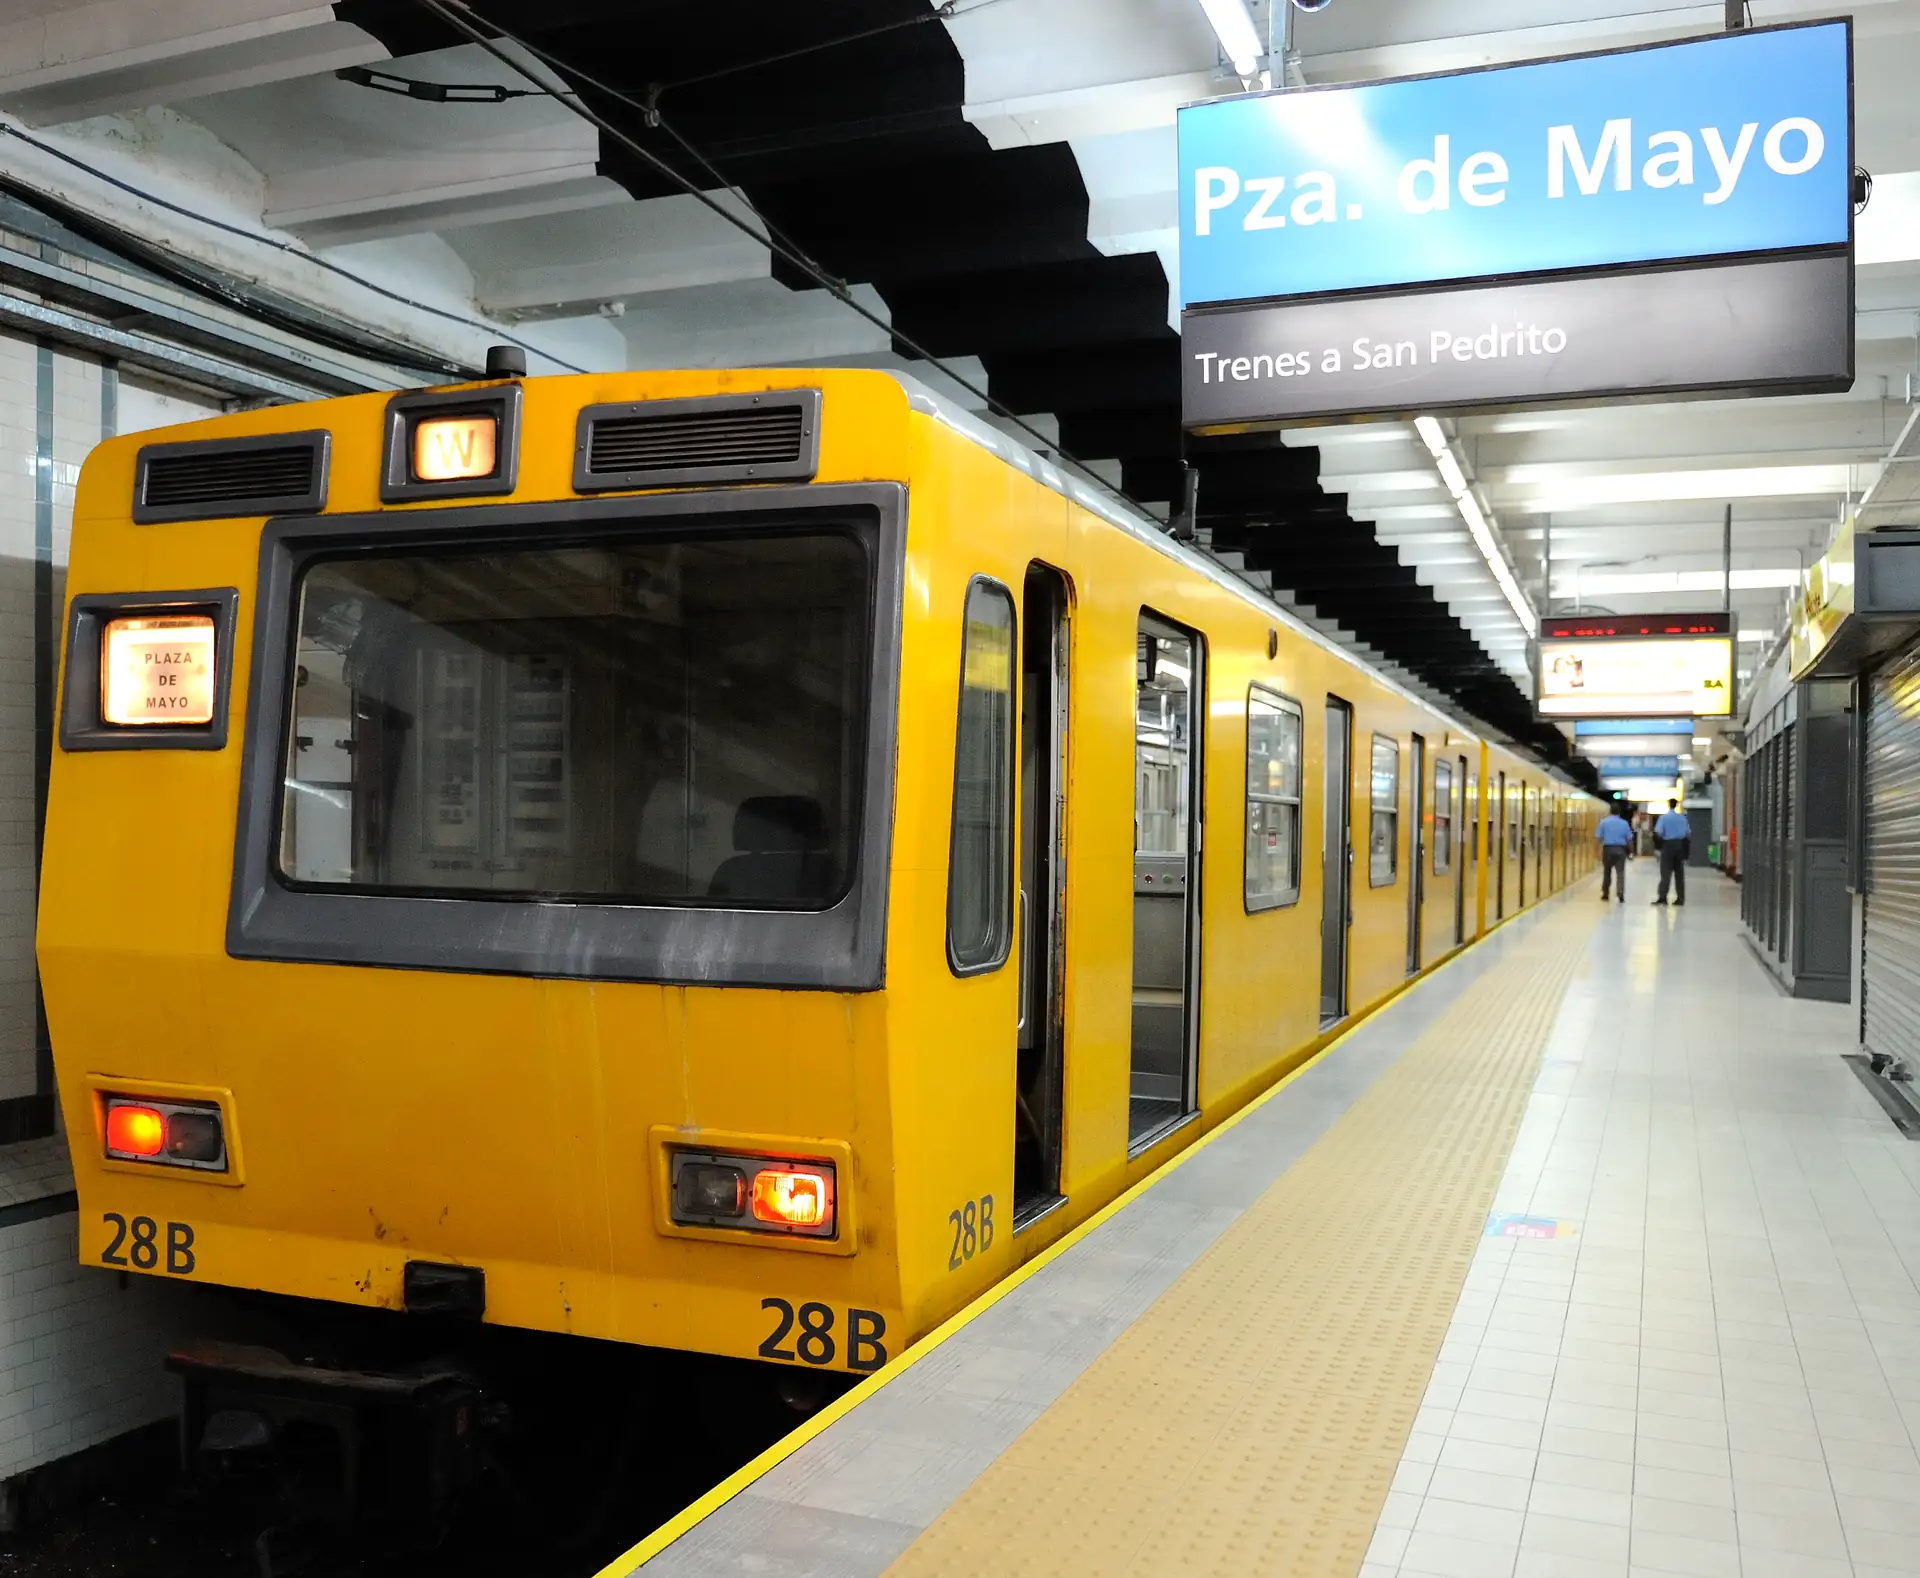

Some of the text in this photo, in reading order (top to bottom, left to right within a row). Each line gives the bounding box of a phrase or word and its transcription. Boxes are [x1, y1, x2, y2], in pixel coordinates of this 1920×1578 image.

[1194, 115, 1825, 237] Pza. de Mayo
[1195, 322, 1567, 384] Trenes a San Pedrito
[435, 429, 475, 468] W
[145, 652, 193, 665] PLAZA
[159, 674, 177, 686] DE
[146, 696, 189, 709] MAYO
[101, 1212, 196, 1275] 28B
[949, 1194, 994, 1272] 28B
[758, 1297, 888, 1371] 28B
